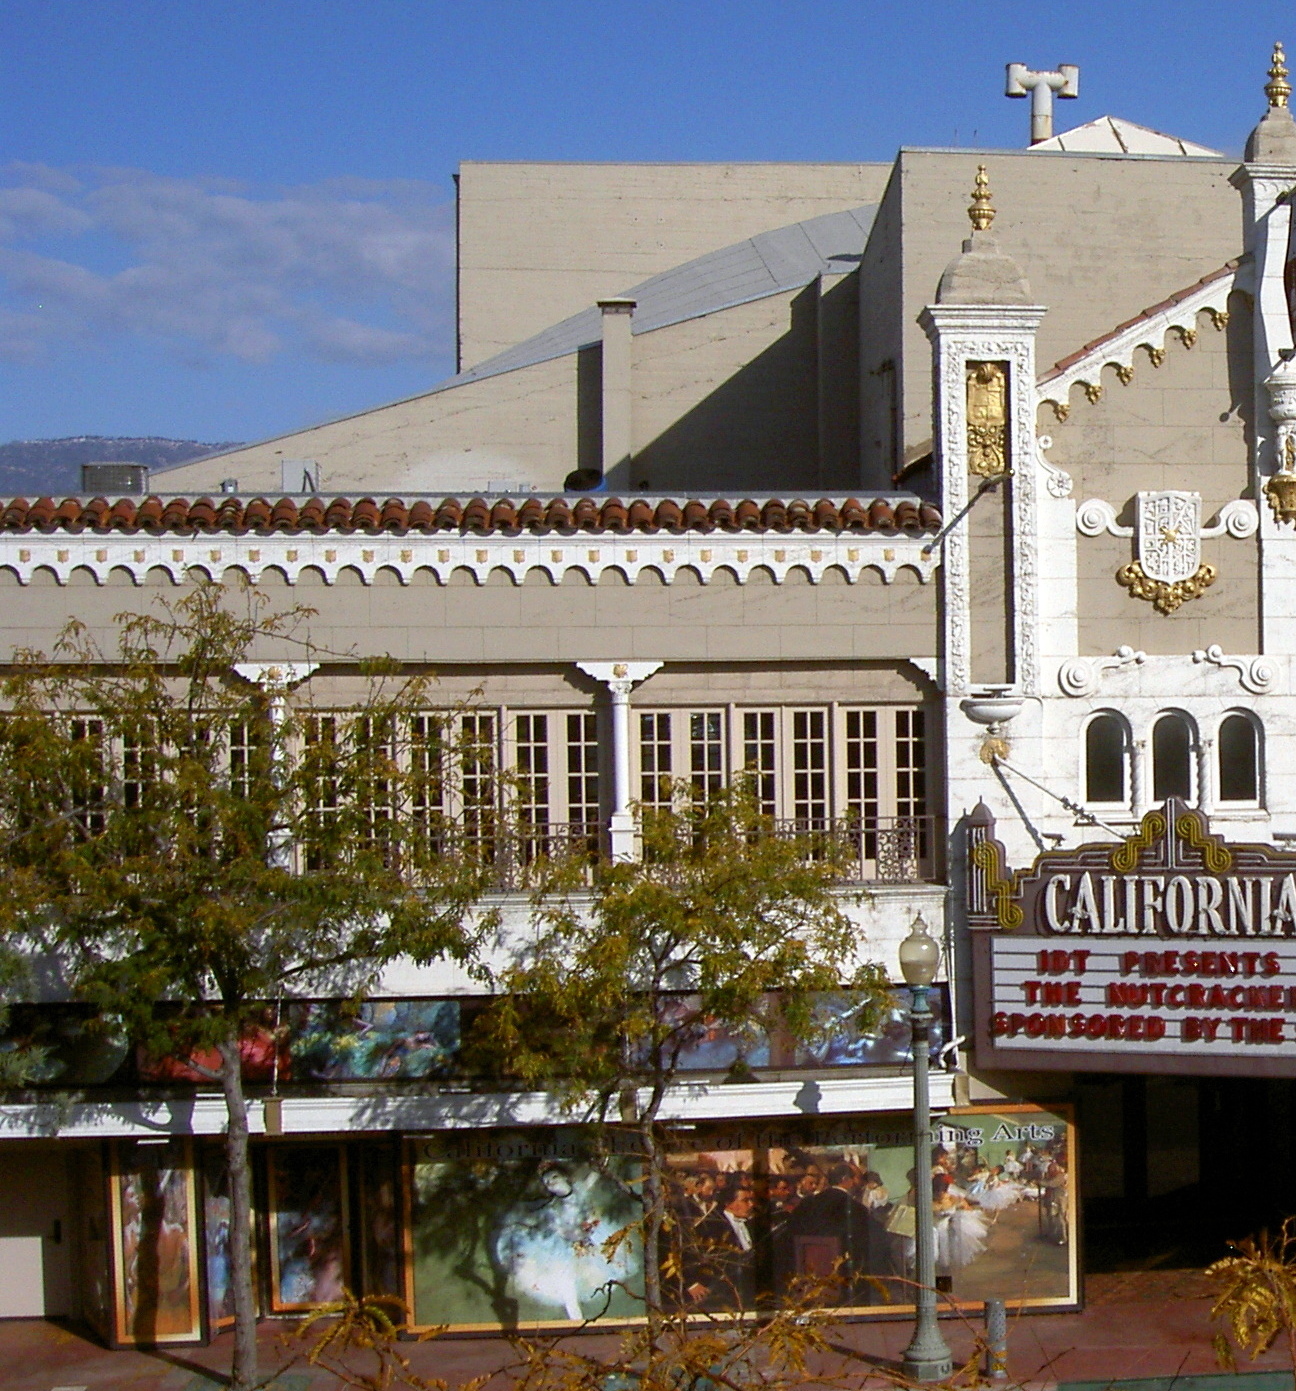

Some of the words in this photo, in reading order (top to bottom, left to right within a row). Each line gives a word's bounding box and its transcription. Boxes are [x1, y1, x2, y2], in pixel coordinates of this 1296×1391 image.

[1119, 950, 1281, 978] PRESENTS
[1020, 981, 1083, 1008] THE
[989, 1011, 1167, 1042] SPONSORED
[1181, 1016, 1222, 1044] BY
[1226, 1017, 1286, 1045] THE
[990, 1121, 1055, 1141] Arts
